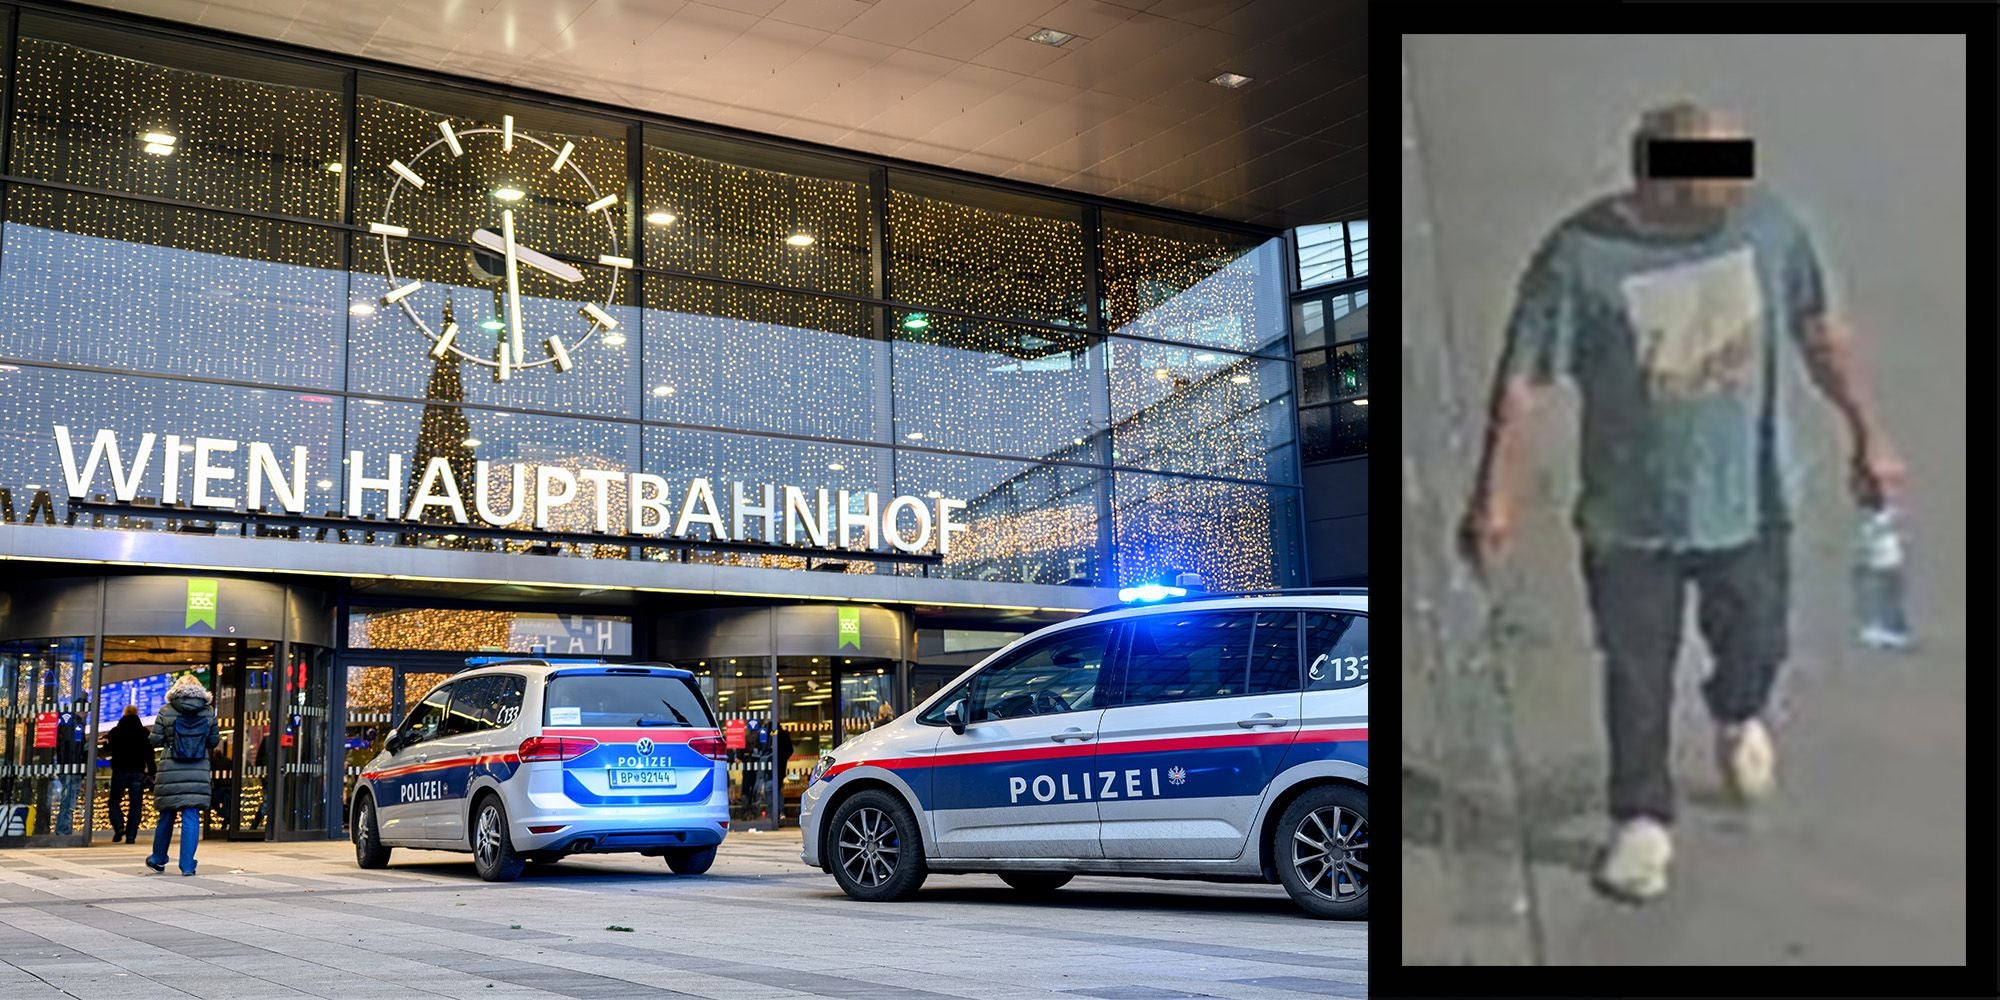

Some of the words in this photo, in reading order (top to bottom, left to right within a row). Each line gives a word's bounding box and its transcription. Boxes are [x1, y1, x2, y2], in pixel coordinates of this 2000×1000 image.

[53, 425, 308, 514] WIEN
[349, 450, 968, 555] HAUPTBAHNHOF
[1331, 656, 1368, 681] 133
[504, 705, 520, 724] 133
[617, 757, 672, 767] POLIZEI
[621, 772, 635, 783] BP
[640, 771, 670, 783] 92144
[1009, 768, 1160, 803] POLIZEI
[400, 780, 442, 802] POLIZEI
